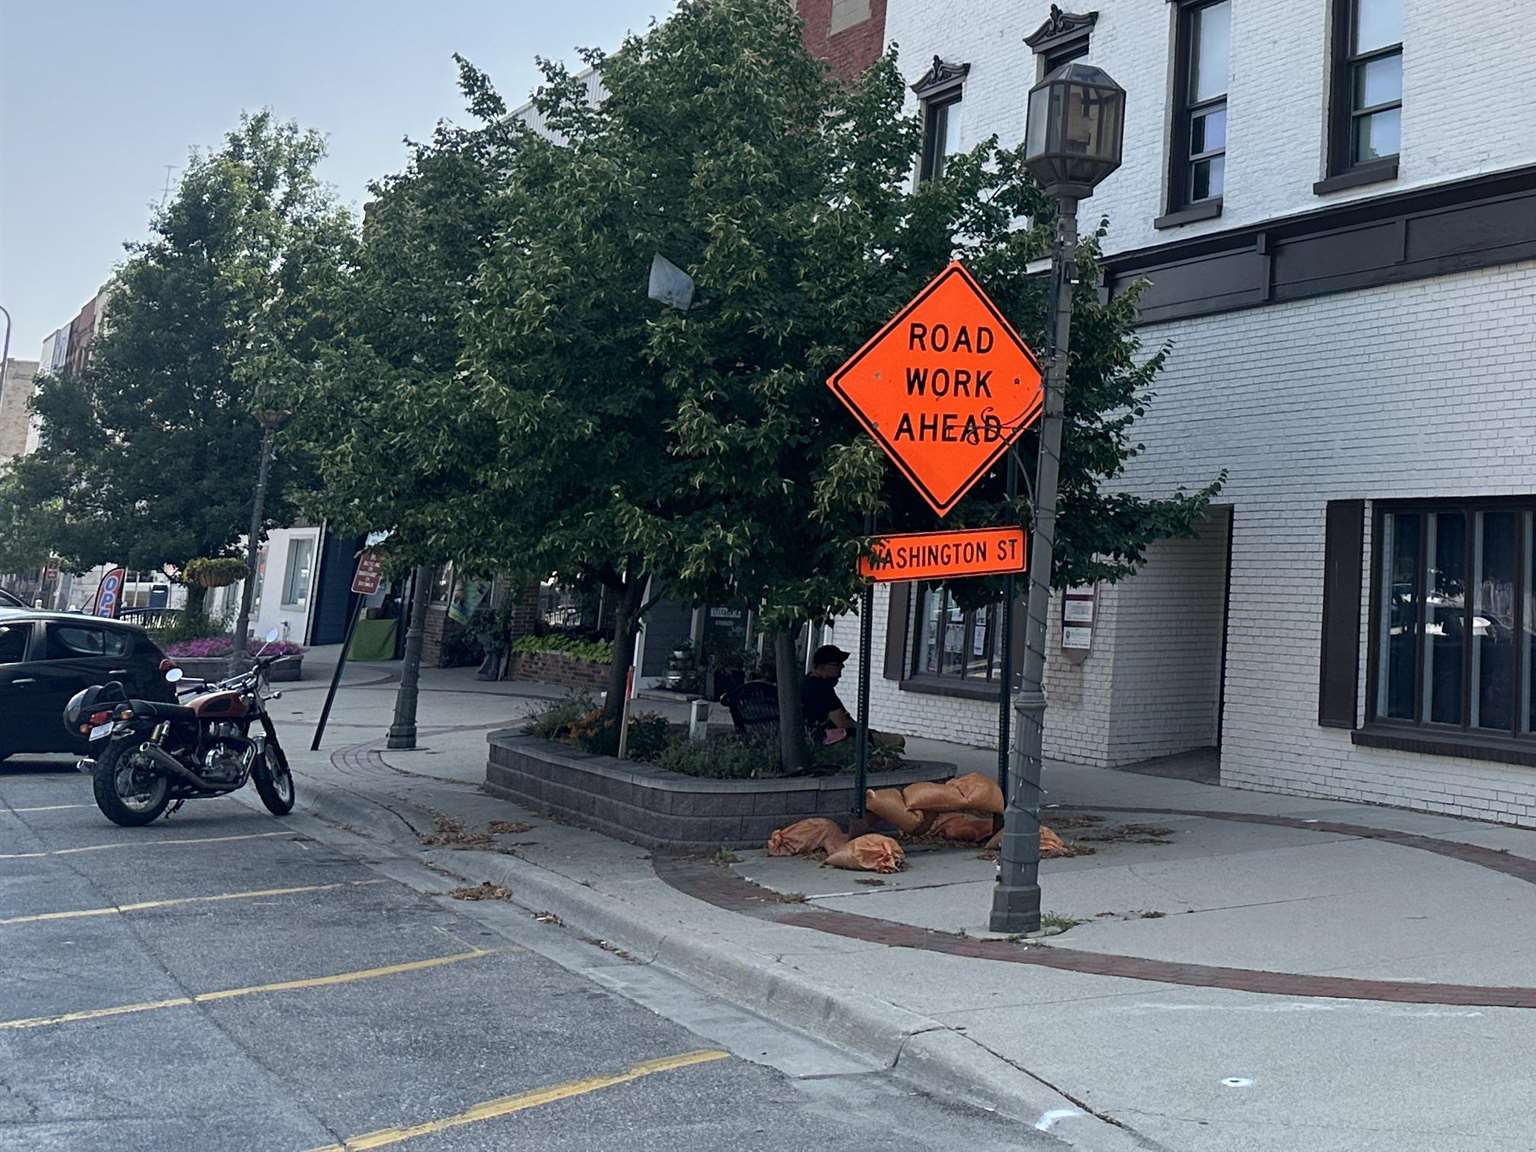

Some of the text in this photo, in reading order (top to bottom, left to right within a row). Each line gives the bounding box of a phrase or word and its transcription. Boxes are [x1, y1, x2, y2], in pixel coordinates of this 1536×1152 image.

[908, 323, 995, 354] ROAD
[905, 368, 993, 398] WORK
[893, 413, 1001, 443] AHEAD
[868, 538, 1018, 571] WASHINGTON ST
[98, 575, 119, 617] OPE
